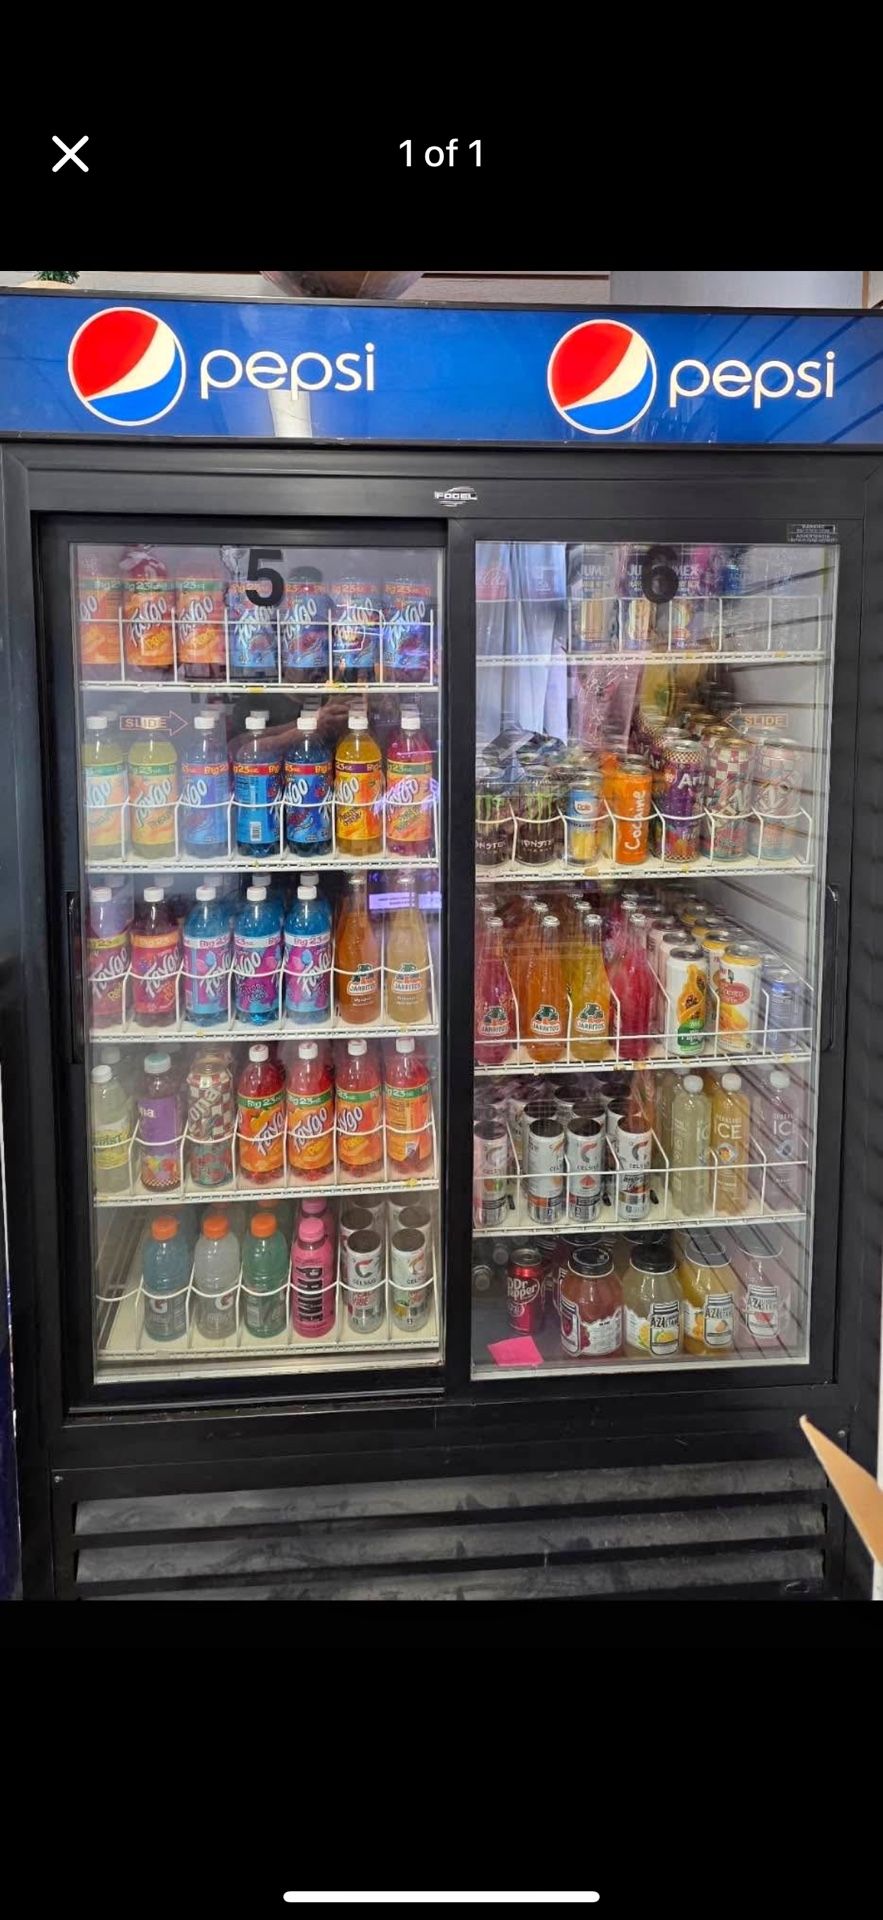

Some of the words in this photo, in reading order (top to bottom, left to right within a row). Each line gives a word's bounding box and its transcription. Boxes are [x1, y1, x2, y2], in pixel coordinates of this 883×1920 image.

[200, 342, 375, 400] pepsi
[669, 350, 836, 409] pepsi
[244, 549, 285, 608] 5
[642, 544, 679, 604] 6
[124, 718, 167, 729] SLIDE
[744, 715, 785, 726] SLIDE
[625, 790, 646, 850] Cocaine
[290, 1107, 328, 1154] Faygo
[714, 1119, 743, 1139] ICE
[296, 1266, 323, 1322] PRIME
[514, 1279, 529, 1289] Dr
